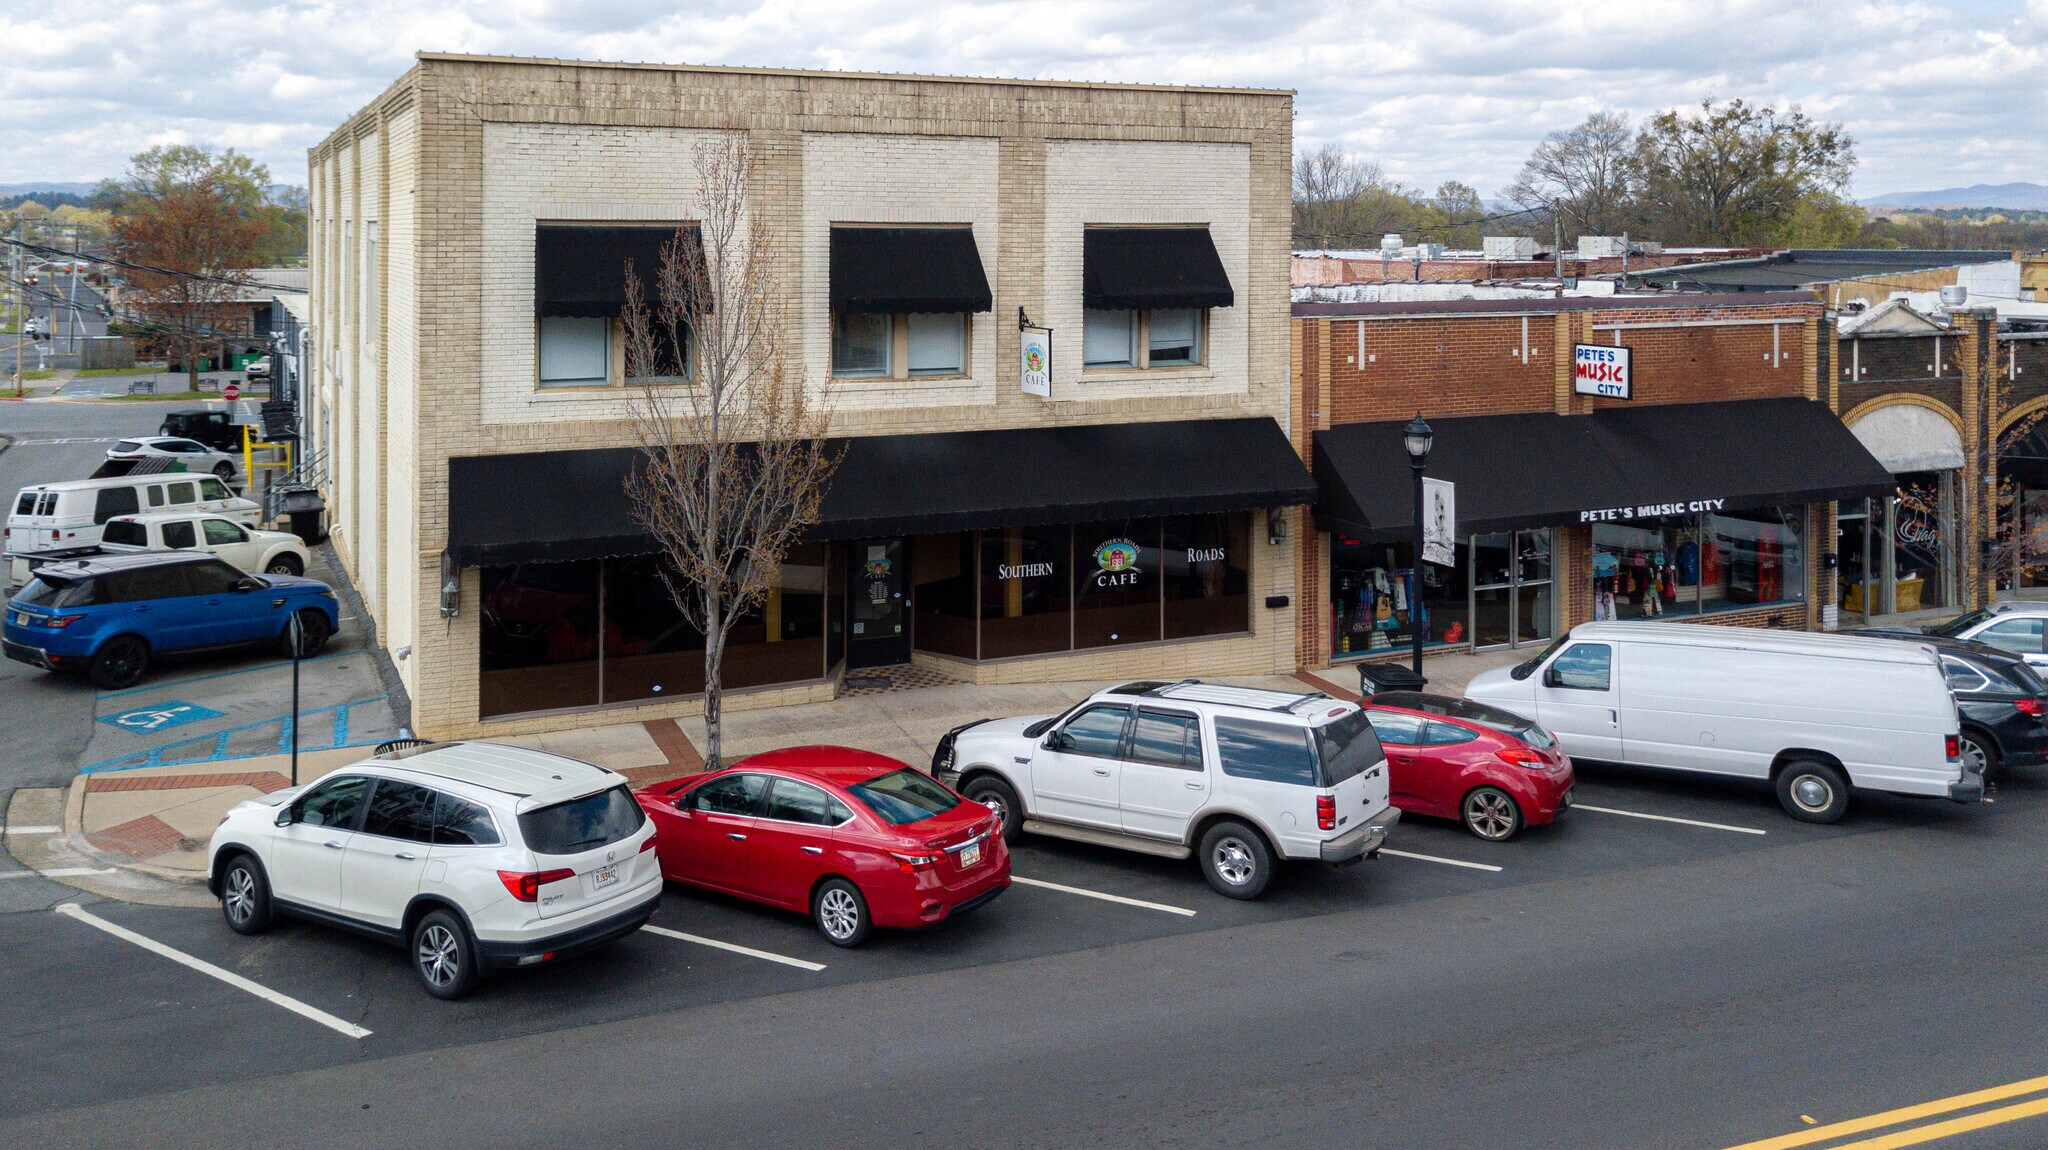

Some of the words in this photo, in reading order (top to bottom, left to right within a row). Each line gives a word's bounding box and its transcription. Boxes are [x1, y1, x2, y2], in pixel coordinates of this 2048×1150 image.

[1577, 348, 1615, 362] PETE'S
[1576, 362, 1624, 382] MUSIC
[1026, 374, 1045, 386] CAFE
[224, 389, 240, 397] STOP
[1597, 383, 1623, 396] CITY
[1580, 507, 1634, 523] PETE'S
[1637, 502, 1685, 518] MUSIC
[1689, 498, 1725, 513] CITY
[1092, 538, 1122, 558] SOUTHERN
[1123, 537, 1142, 554] ROADS
[1187, 547, 1225, 563] ROADS
[998, 562, 1053, 580] SOUTHERN
[1097, 573, 1138, 587] CAFE
